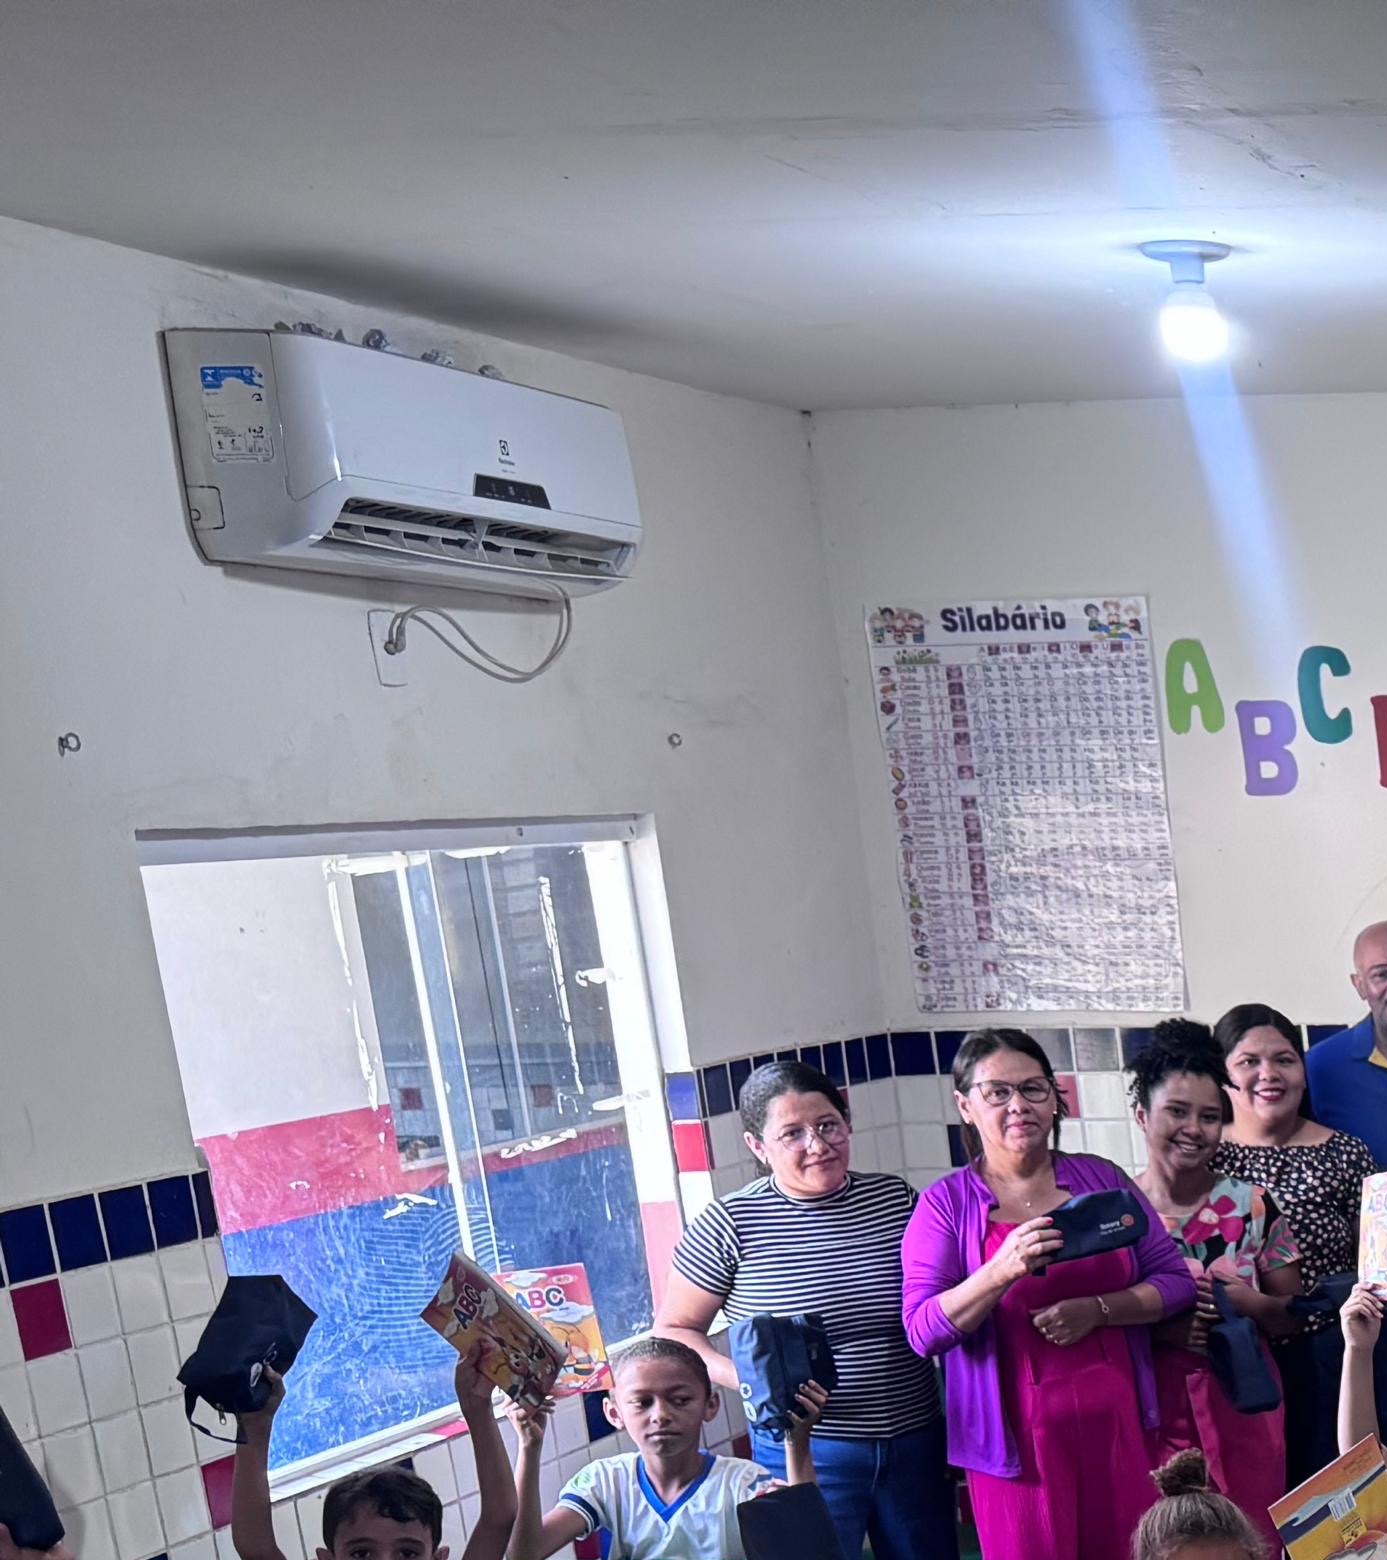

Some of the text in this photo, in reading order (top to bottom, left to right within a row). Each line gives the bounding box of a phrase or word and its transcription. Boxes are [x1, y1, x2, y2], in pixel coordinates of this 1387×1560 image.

[939, 605, 1068, 635] Silabário
[1164, 638, 1225, 735] A
[1234, 699, 1298, 797] B
[1297, 645, 1353, 744] C
[453, 1283, 482, 1331] ABC
